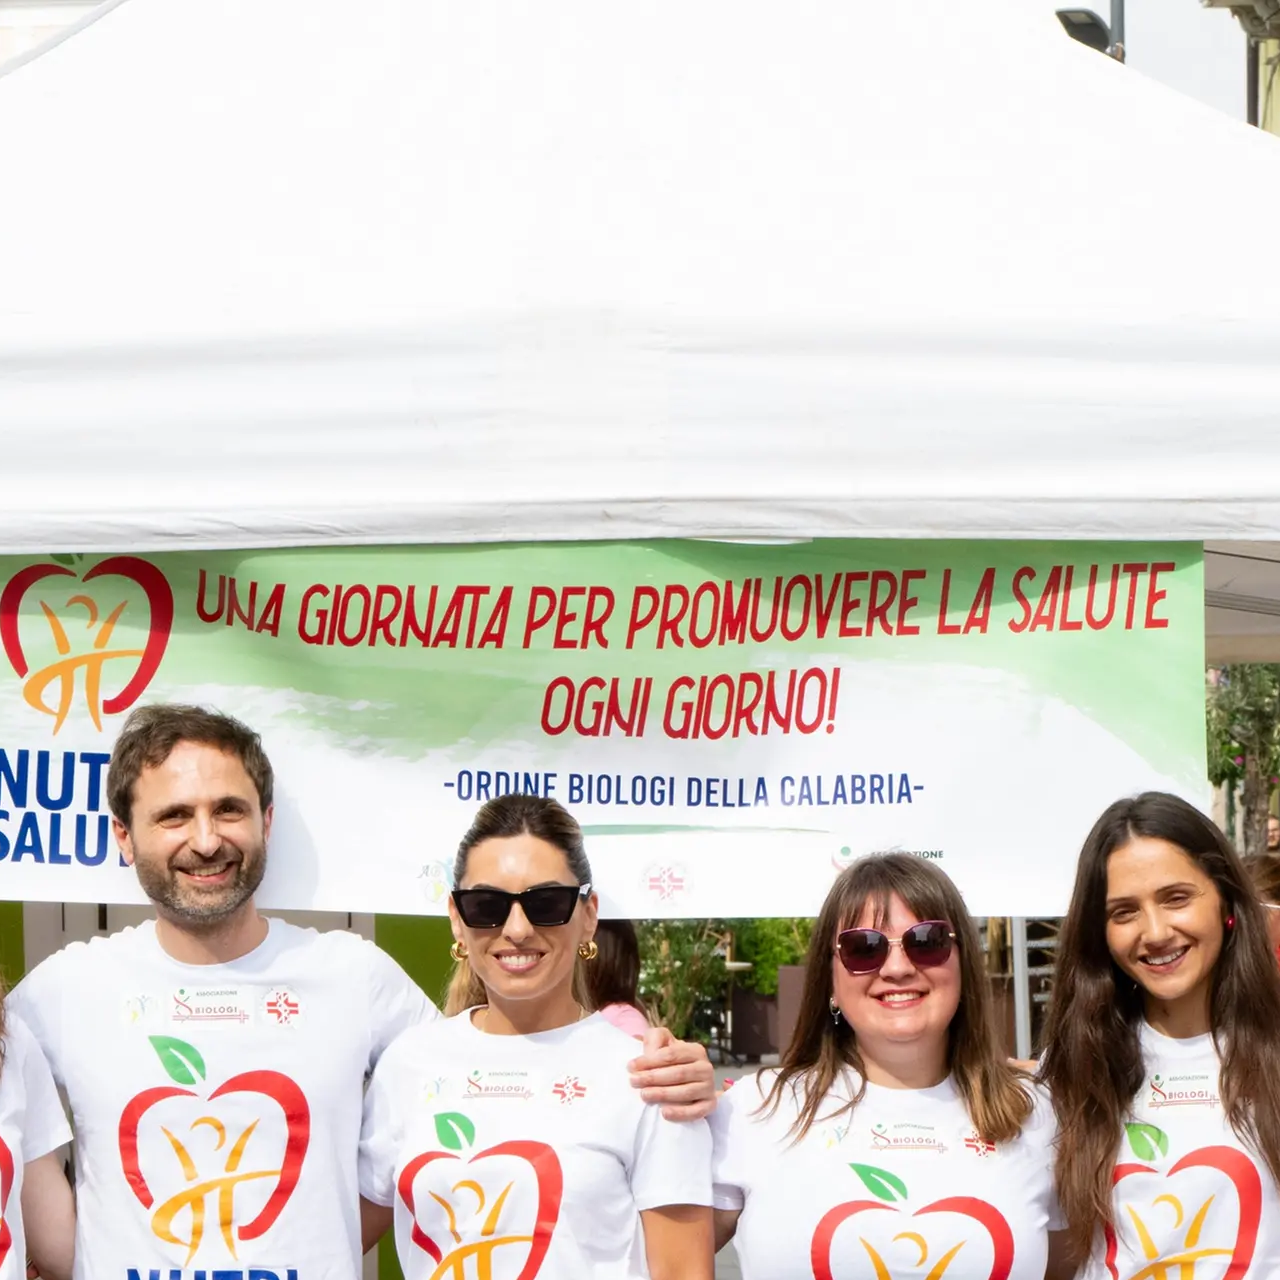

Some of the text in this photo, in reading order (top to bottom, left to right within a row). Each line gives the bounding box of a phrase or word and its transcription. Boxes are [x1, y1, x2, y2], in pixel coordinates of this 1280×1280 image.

[197, 562, 1177, 650] UNA GIORNATA PER PROMUOVERE LA SALUTE
[540, 667, 842, 740] OGNI GIORNO!
[443, 770, 925, 808] -ORDINE BIOLOGI DELLA CALABRIA-
[195, 1006, 238, 1014] BIOLOGI
[1169, 1091, 1208, 1099] BIOLOGI
